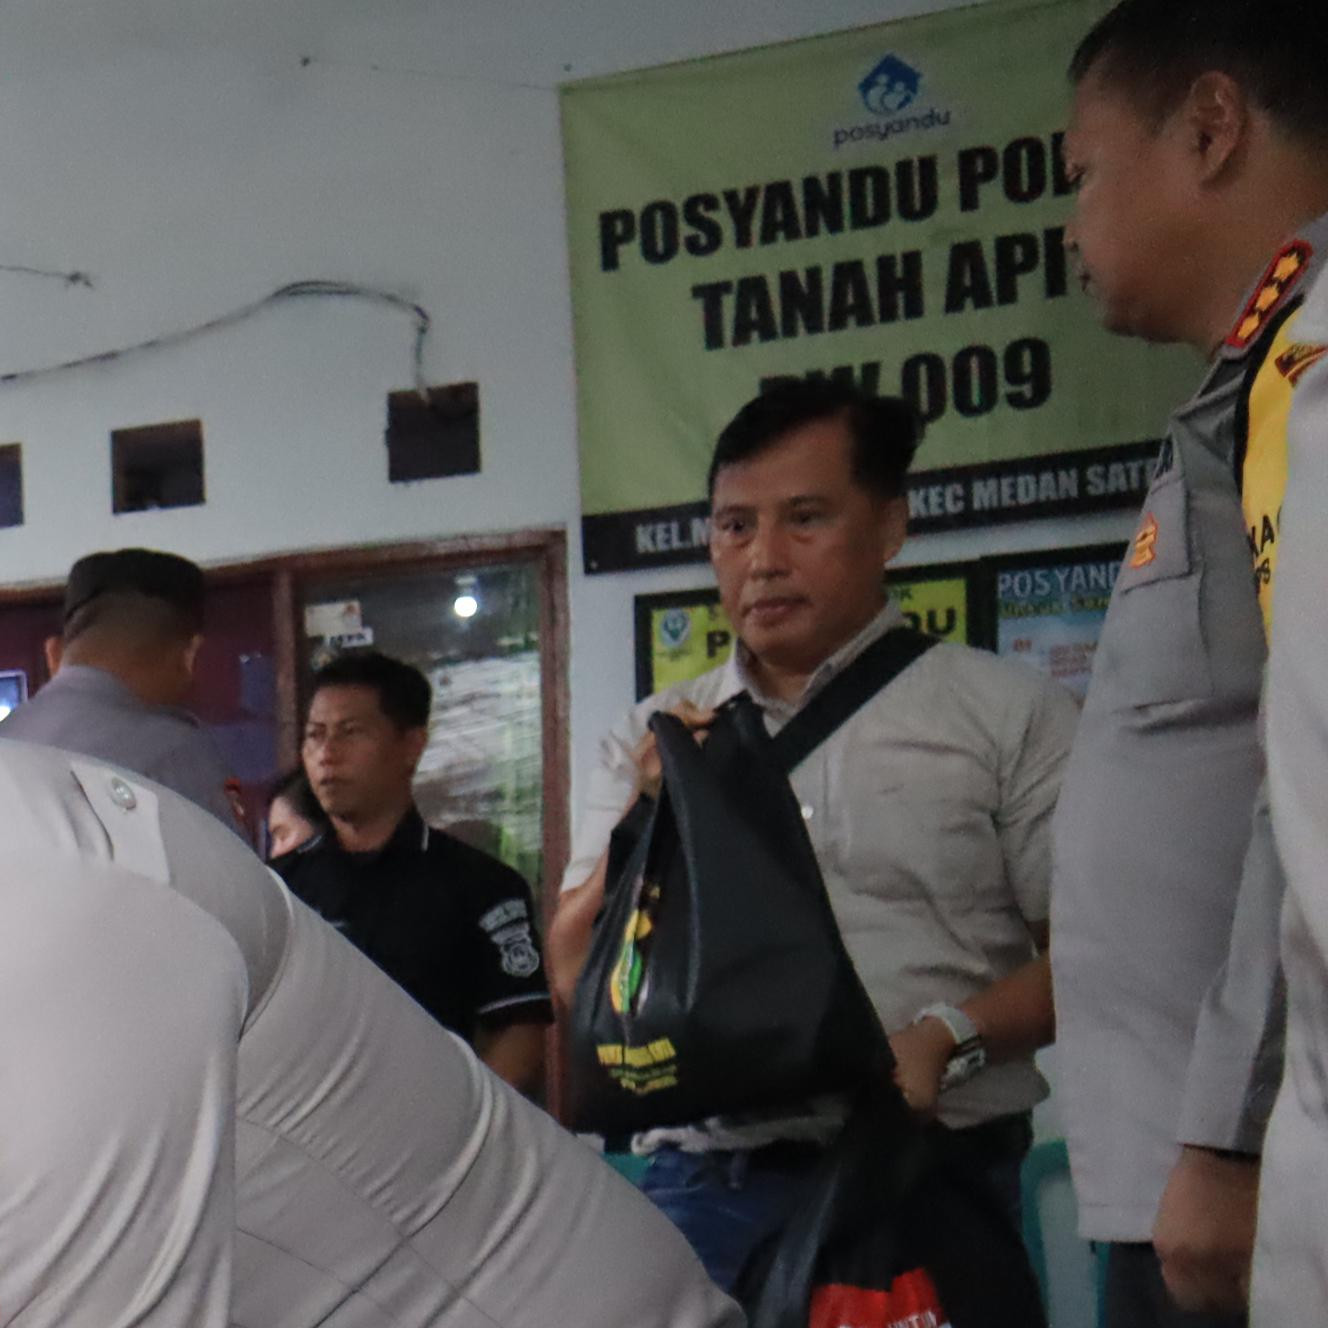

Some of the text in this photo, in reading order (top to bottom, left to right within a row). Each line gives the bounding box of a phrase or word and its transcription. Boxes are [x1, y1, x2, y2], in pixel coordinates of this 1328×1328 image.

[833, 107, 952, 150] posyandu
[599, 153, 940, 272] POSYANDU
[692, 224, 1070, 352] TANAH API
[907, 481, 966, 519] KEC
[971, 467, 1080, 512] MEDAN
